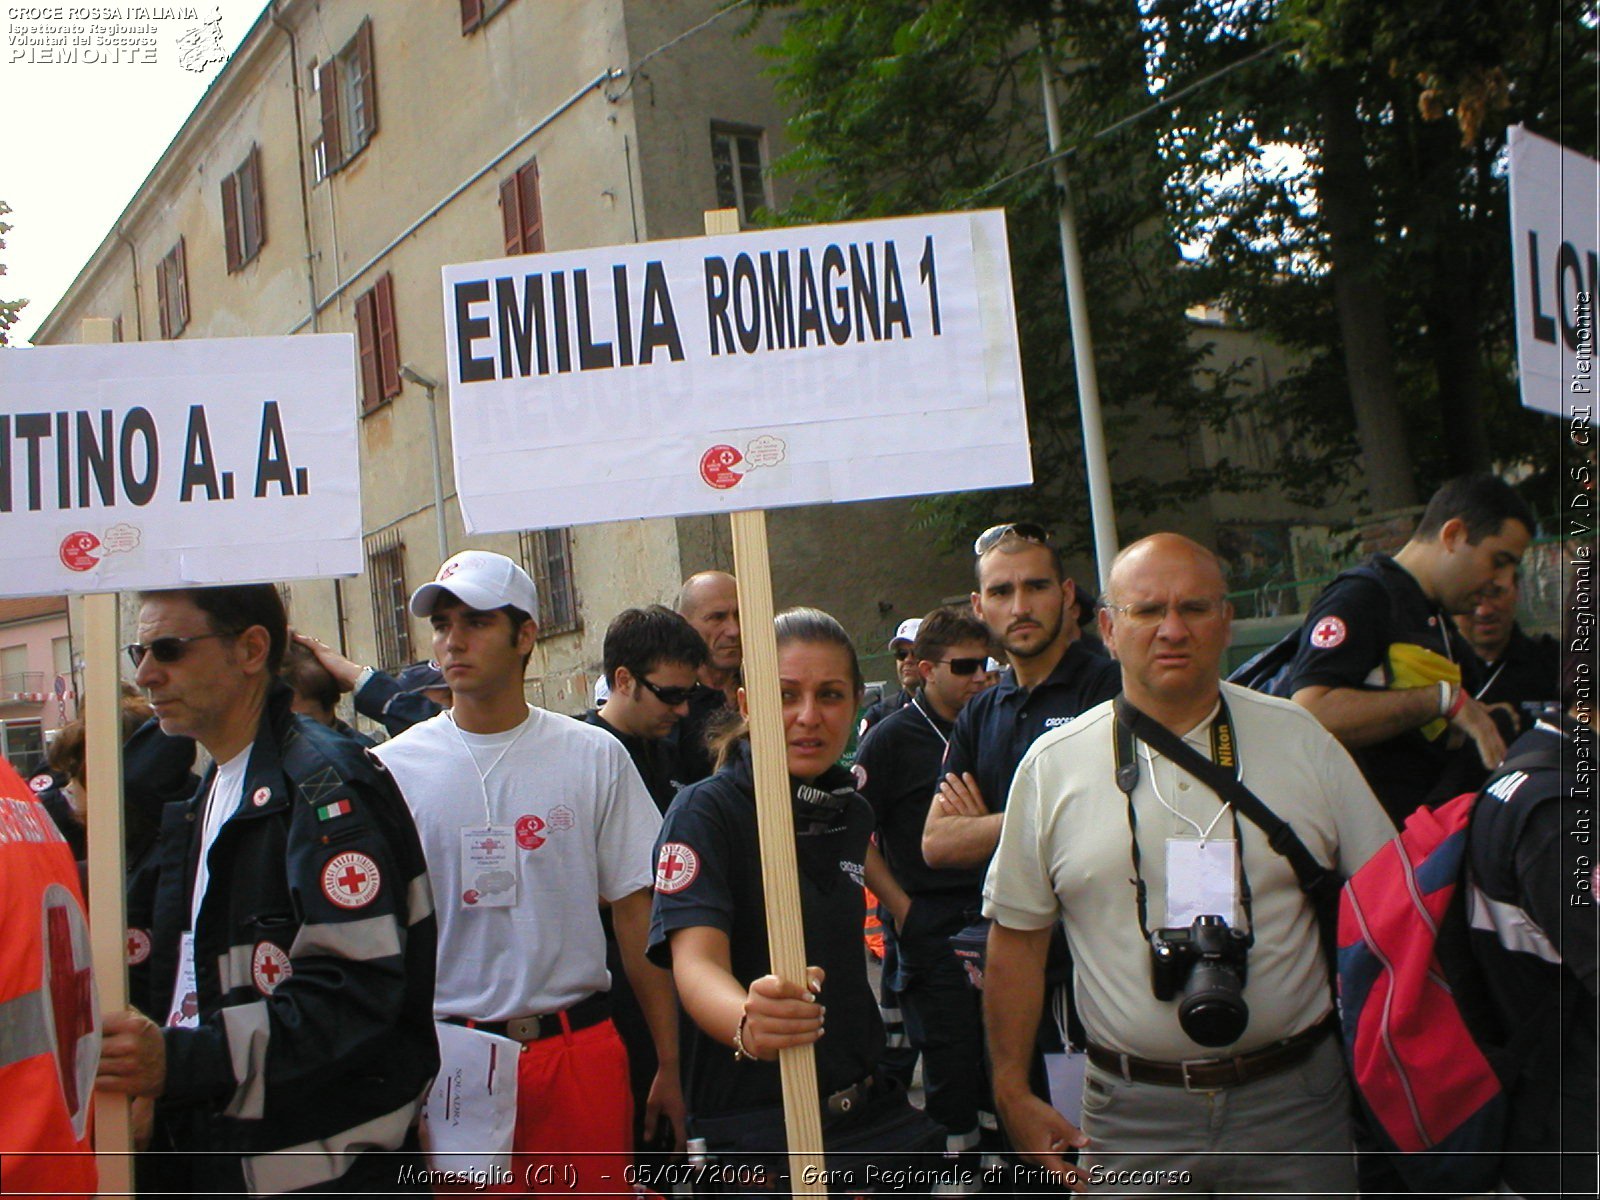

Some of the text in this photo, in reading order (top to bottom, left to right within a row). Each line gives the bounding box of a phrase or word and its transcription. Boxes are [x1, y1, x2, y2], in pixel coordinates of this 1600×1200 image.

[452, 234, 942, 384] EMILIA ROMAGNA 1
[1528, 228, 1600, 357] LO
[180, 404, 235, 502] A.
[254, 400, 309, 499] A.
[1218, 724, 1233, 767] Nikon
[452, 1067, 463, 1128] SQUADRA
